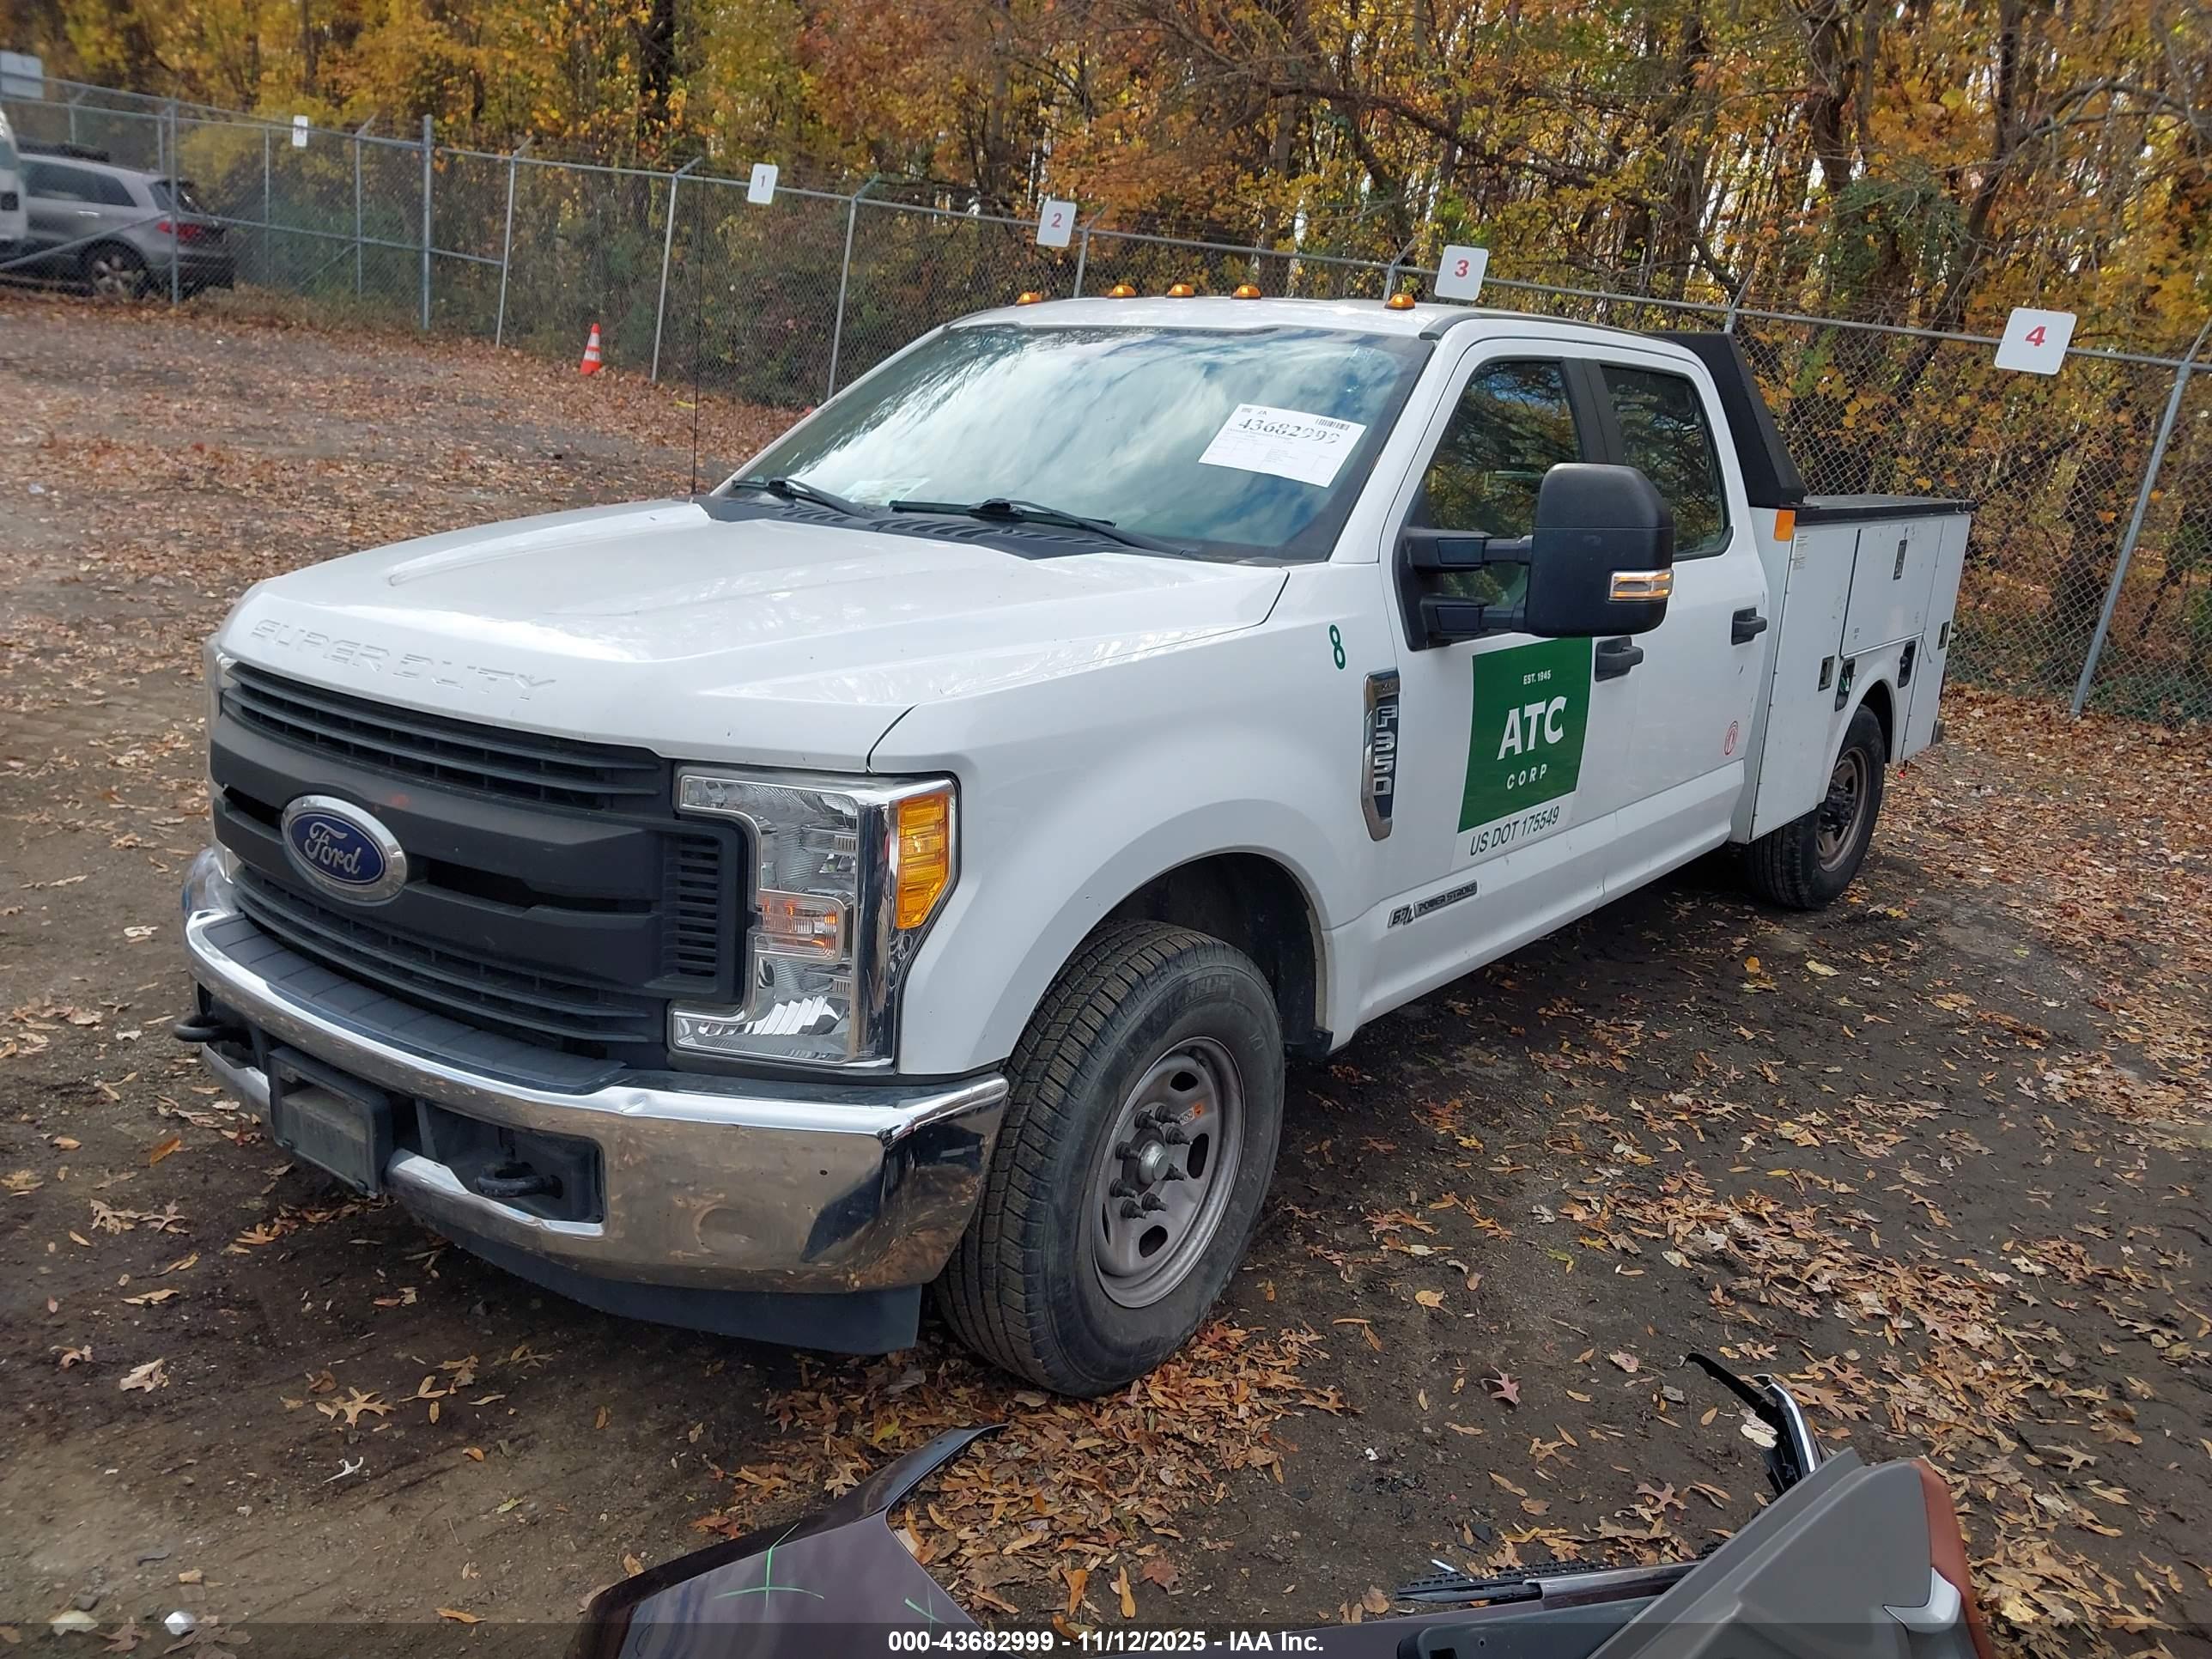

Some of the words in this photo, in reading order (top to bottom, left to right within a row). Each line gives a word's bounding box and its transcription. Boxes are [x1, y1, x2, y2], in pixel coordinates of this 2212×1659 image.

[1050, 212, 1062, 228] 2
[1455, 259, 1469, 277] 3
[2025, 325, 2047, 347] 4
[1238, 418, 1340, 444] 43682999
[250, 618, 390, 673] SUPER
[392, 653, 557, 701] DUTY
[1328, 624, 1346, 670] 8
[1522, 672, 1536, 685] EST.
[1537, 670, 1552, 683] 1945
[1496, 695, 1568, 761] ATC
[1506, 763, 1547, 790] CORP
[1469, 830, 1490, 857] US
[1491, 819, 1520, 848] DOT
[1521, 805, 1560, 836] 175549
[304, 821, 362, 874] Ford
